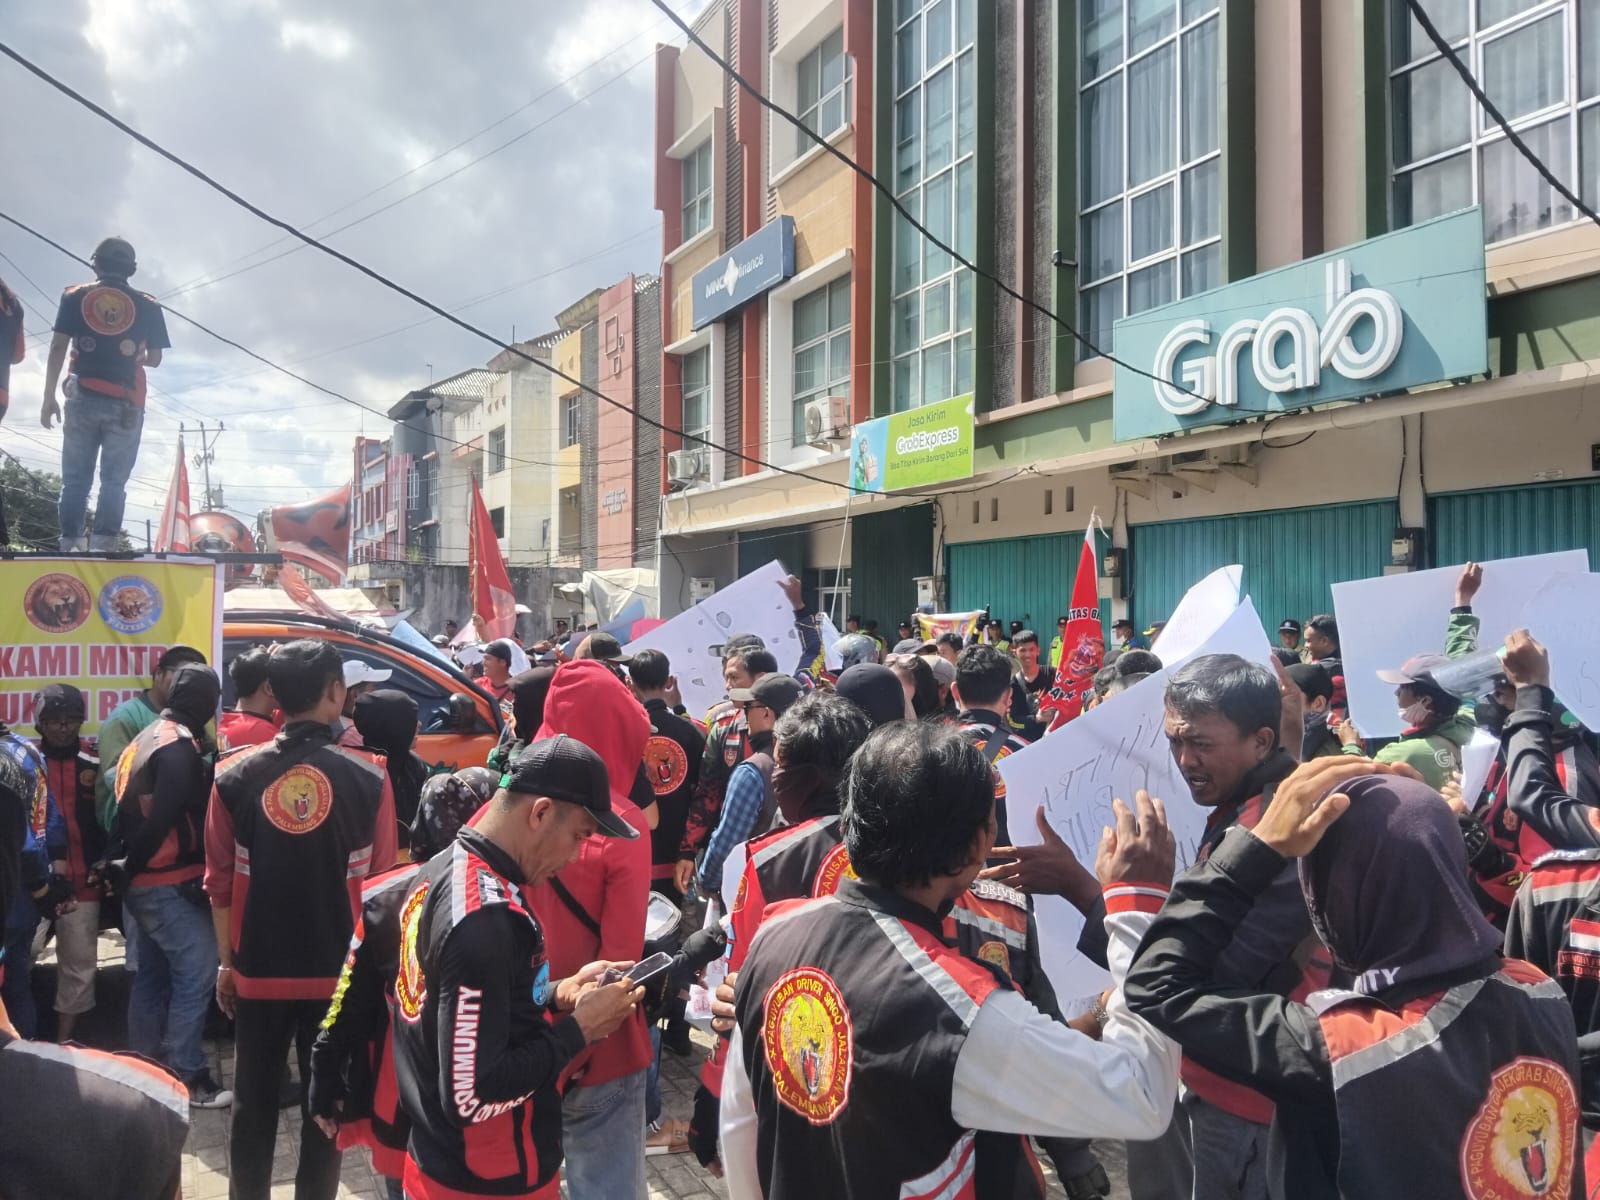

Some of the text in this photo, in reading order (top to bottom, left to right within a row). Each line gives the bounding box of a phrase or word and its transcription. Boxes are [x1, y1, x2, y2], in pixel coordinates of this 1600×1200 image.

[738, 253, 764, 278] finance
[1153, 259, 1404, 415] Grab
[908, 410, 946, 428] Jasa Kirim
[896, 427, 958, 453] GrabExpress
[926, 453, 945, 463] Barang
[946, 450, 957, 459] Dari
[958, 446, 969, 456] Sini
[0, 645, 170, 677] KAMI MITR
[980, 884, 1024, 907] DRIVER
[453, 986, 482, 1117] COMMUNITY
[767, 978, 847, 1096] PAGUYUBAN DRIVER SINGO JALANAN
[774, 1070, 833, 1116] PALEMBANG
[1470, 1108, 1499, 1174] PAGUYUBAN
